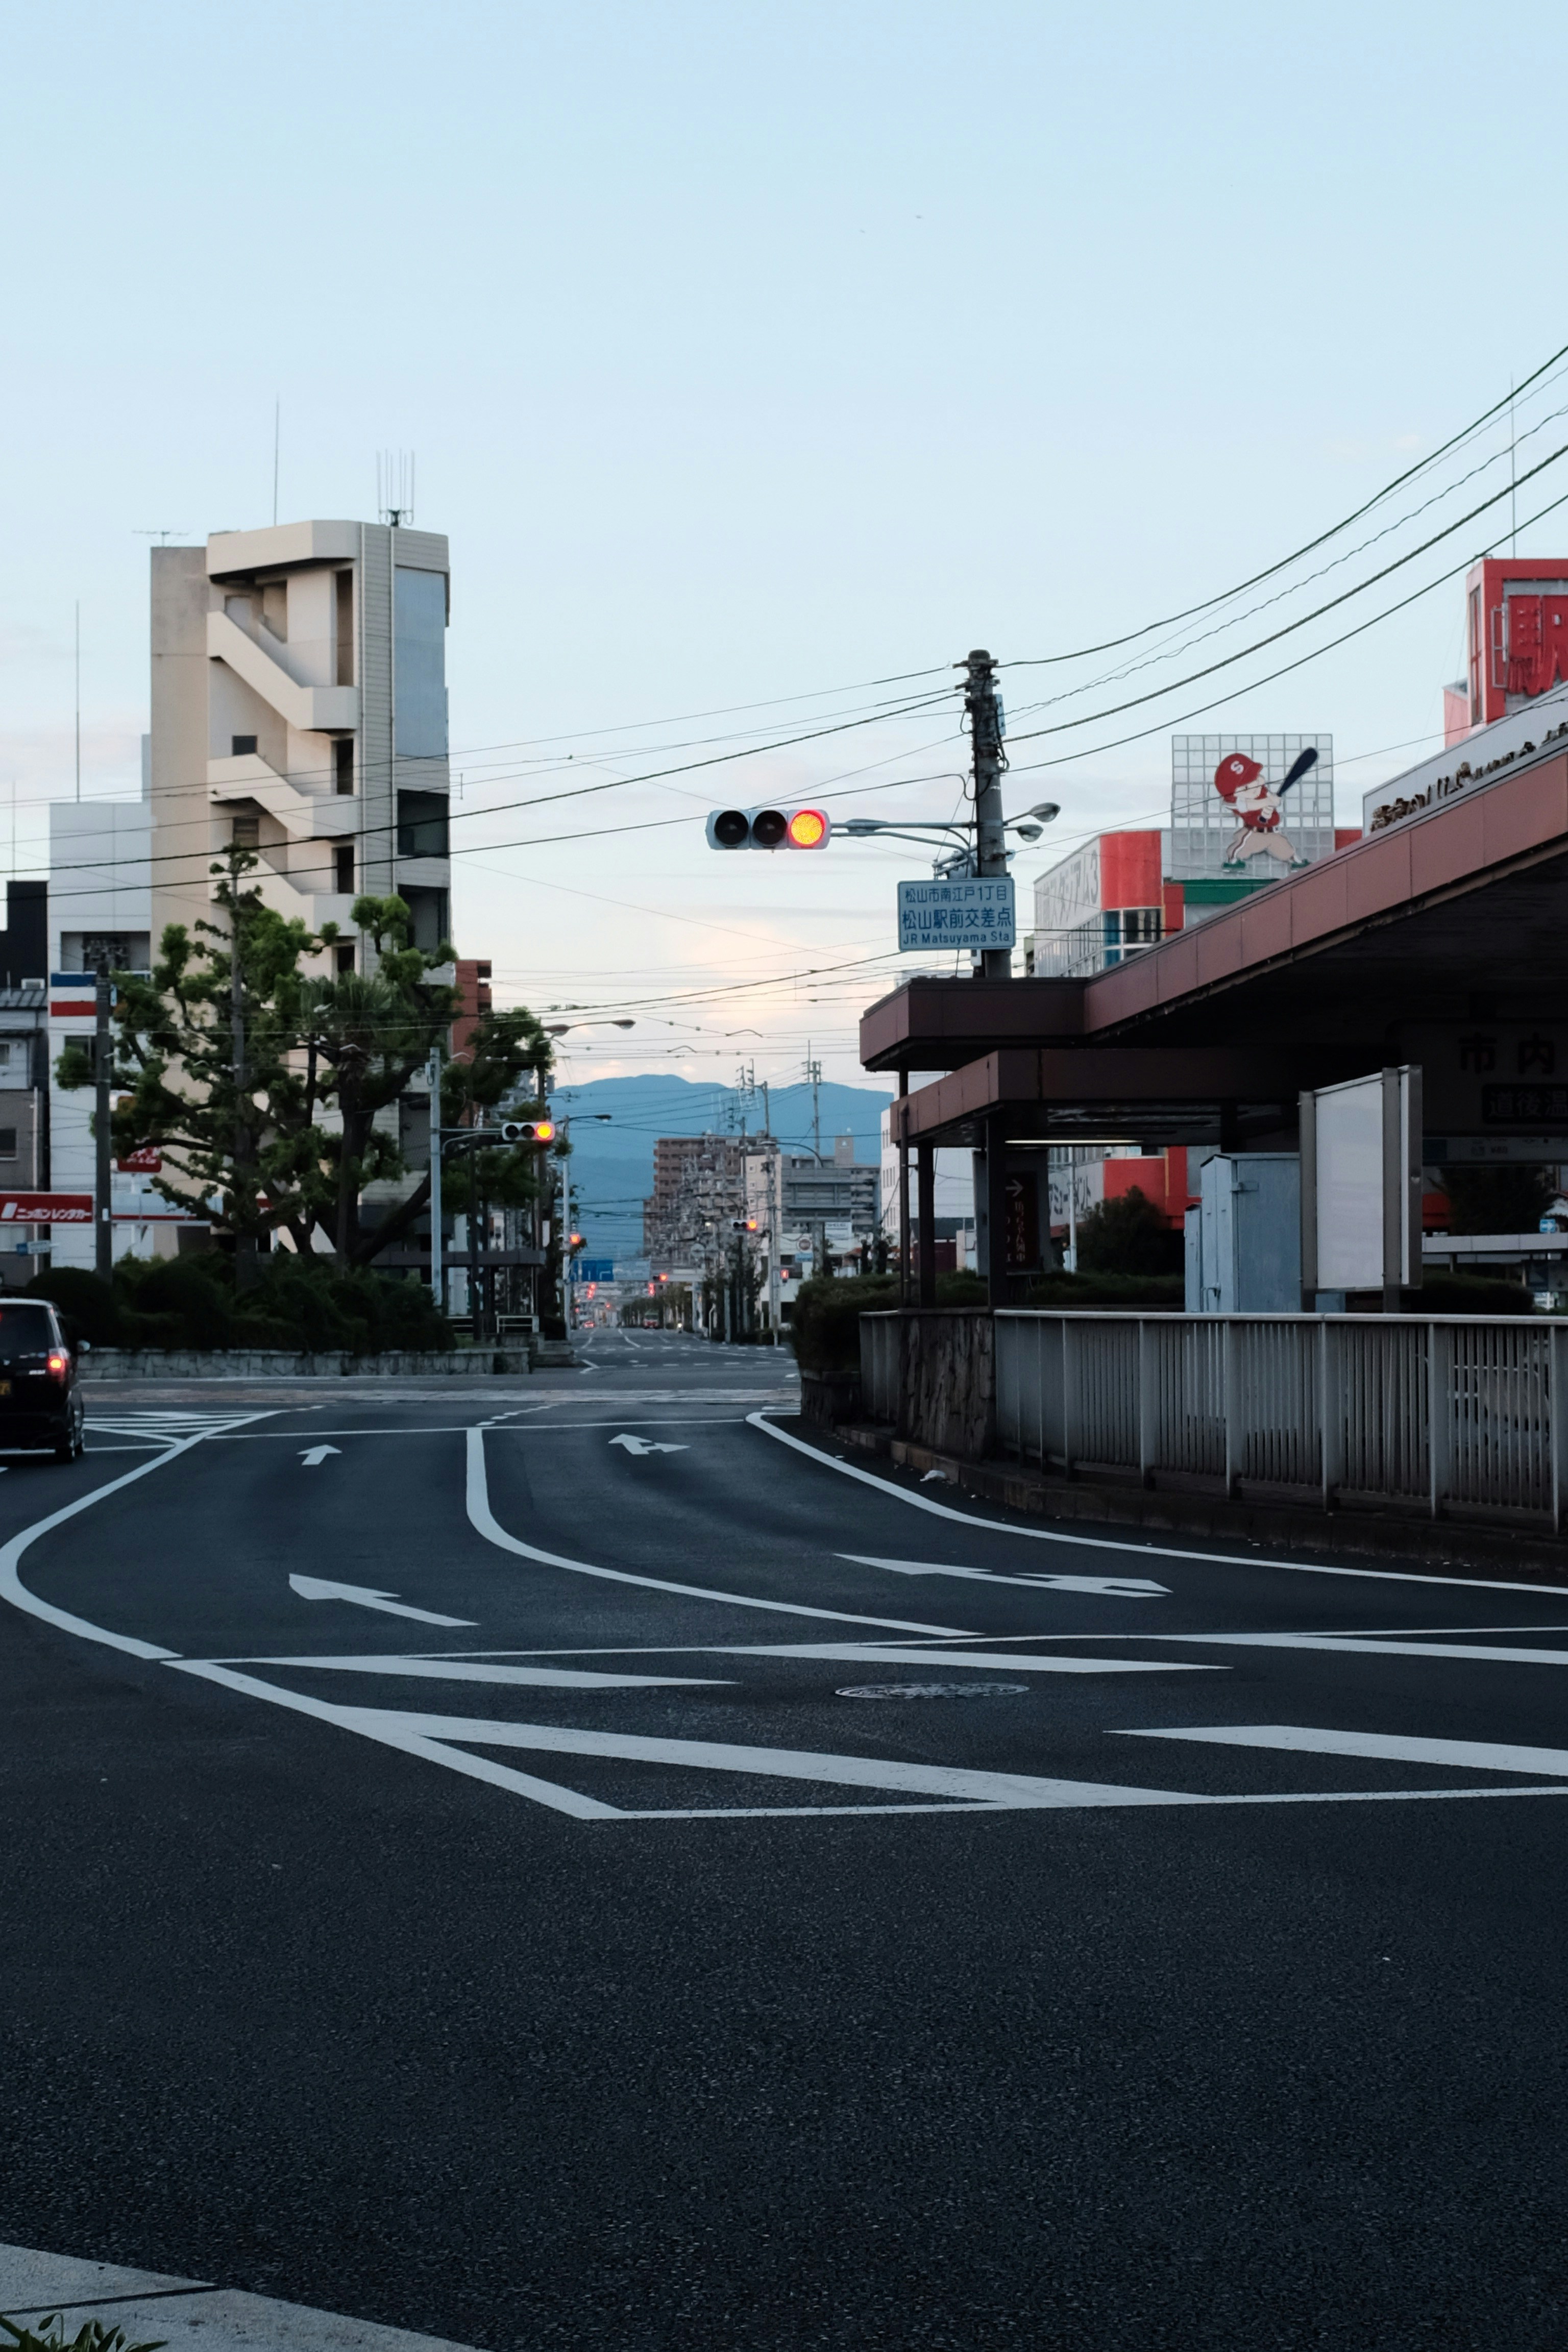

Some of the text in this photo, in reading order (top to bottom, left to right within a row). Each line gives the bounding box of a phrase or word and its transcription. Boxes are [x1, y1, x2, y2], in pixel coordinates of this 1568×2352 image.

[1230, 760, 1244, 775] S
[905, 885, 1007, 904] 松山市南江戸1丁目
[901, 906, 1012, 931] 松山駅前交差点
[903, 932, 1010, 945] JR Matsuyama Sta
